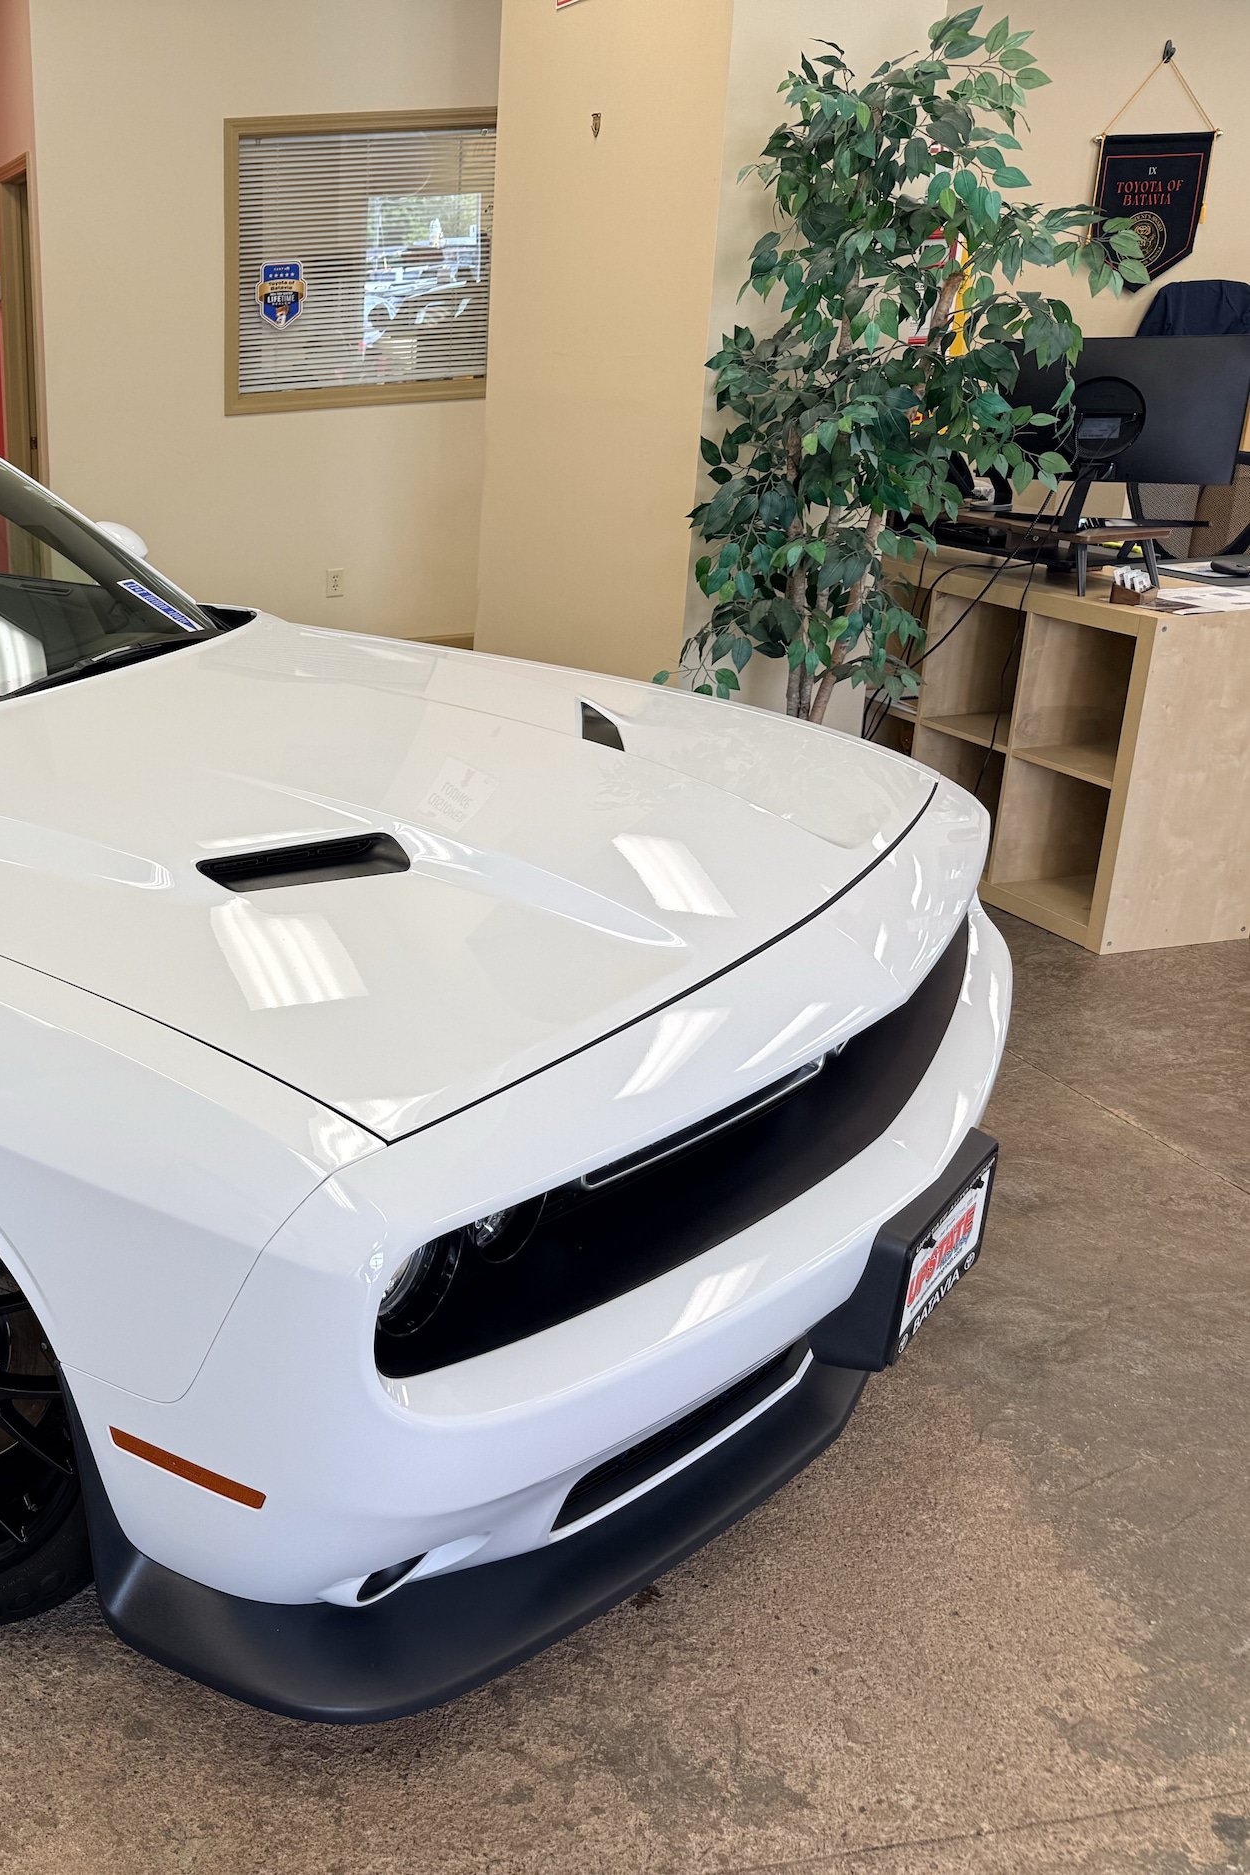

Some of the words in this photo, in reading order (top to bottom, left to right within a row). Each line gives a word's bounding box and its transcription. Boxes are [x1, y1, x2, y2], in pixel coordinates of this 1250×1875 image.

[1116, 180, 1162, 194] TOYOTA
[1167, 179, 1184, 192] OF
[1123, 193, 1171, 206] BATAVIA
[907, 1202, 977, 1307] UPSTATE
[912, 1269, 960, 1336] BATAVIA
